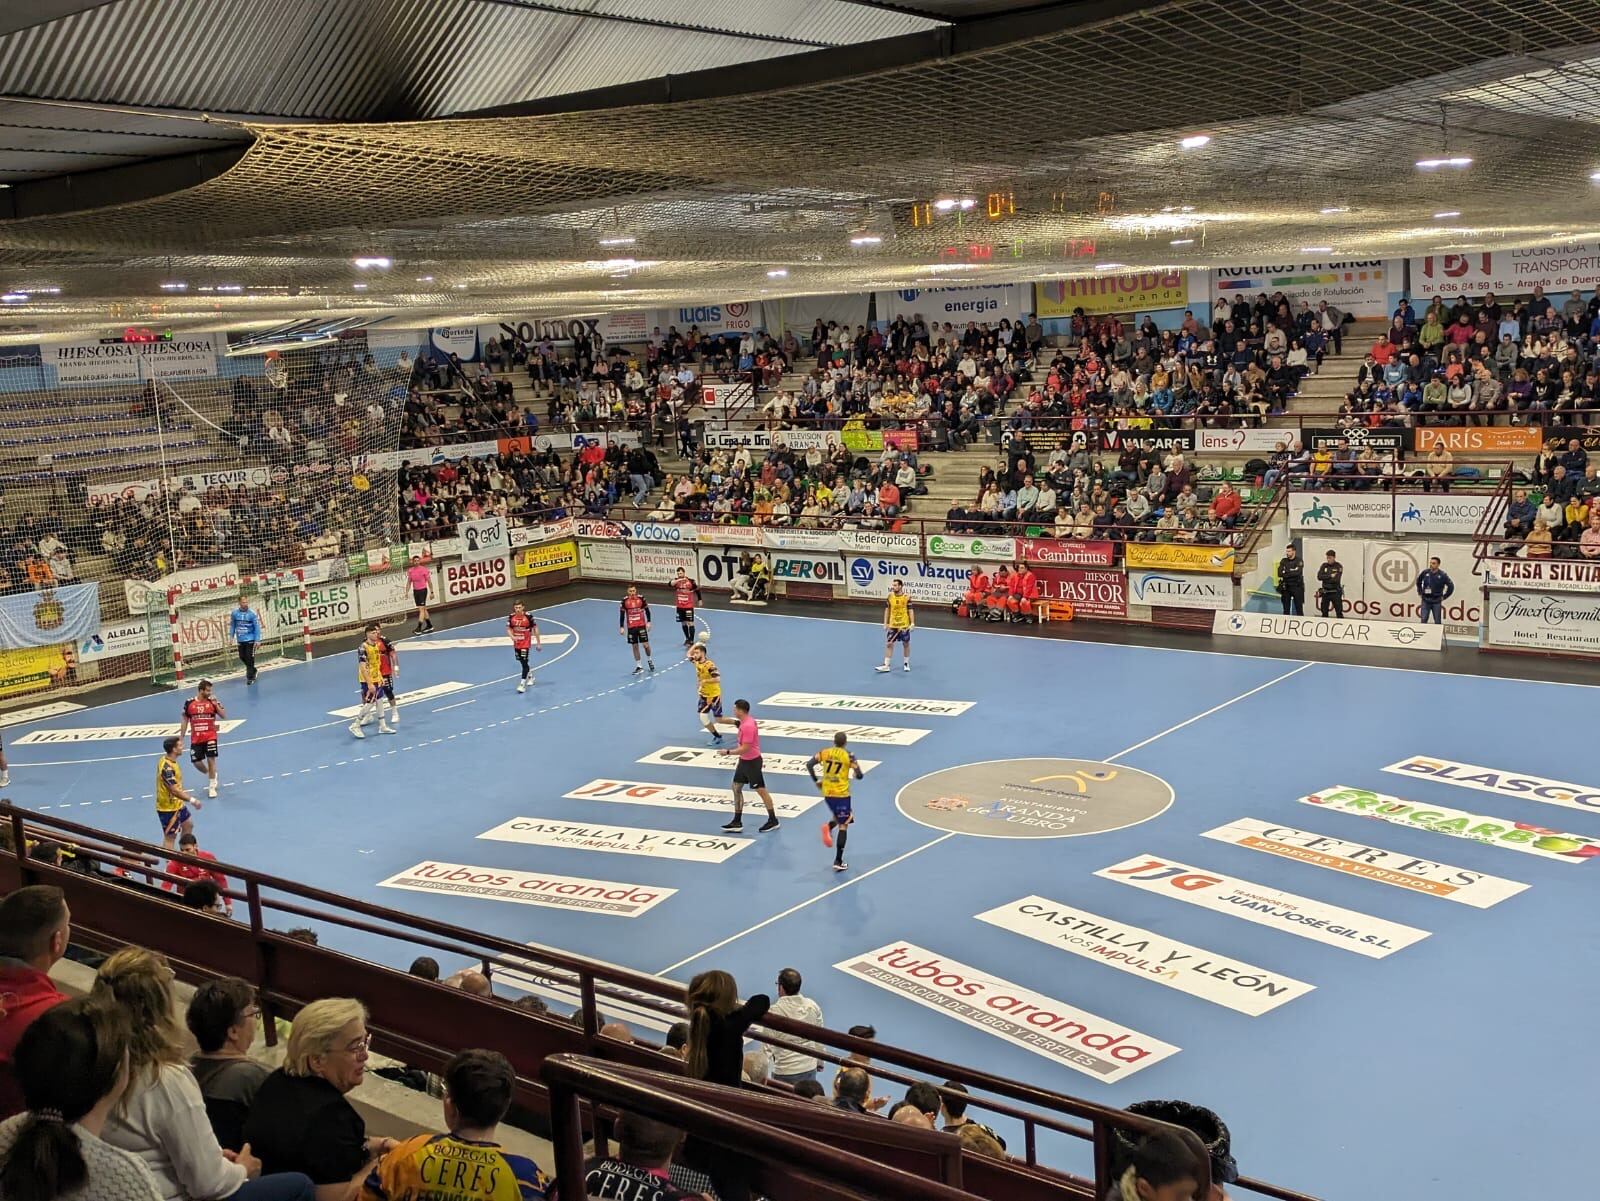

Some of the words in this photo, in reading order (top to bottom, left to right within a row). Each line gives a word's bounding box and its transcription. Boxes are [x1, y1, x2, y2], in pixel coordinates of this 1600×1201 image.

[1440, 282, 1458, 292] 636
[1461, 282, 1474, 291] 84
[1494, 281, 1504, 289] 15
[1517, 278, 1551, 288] Aranda
[1556, 277, 1568, 285] de
[944, 297, 998, 314] energía
[725, 319, 750, 329] FRIGO
[57, 344, 134, 360] HIESCOSA
[142, 341, 213, 355] HIESCOSA
[719, 434, 739, 448] Cepa
[742, 434, 752, 445] de
[754, 434, 770, 446] Oro
[1201, 431, 1228, 449] lens
[1420, 428, 1484, 449] PARÍS
[201, 470, 247, 486] TECVIR
[1346, 503, 1392, 512] INMOBICORP
[634, 555, 655, 564] RAFA
[1037, 547, 1108, 565] Gambrinus
[447, 558, 506, 581] BASILIO
[877, 560, 909, 577] Siro
[1501, 562, 1543, 580] CASA
[1549, 563, 1600, 583] SILVIA
[449, 573, 507, 596] CRIADO
[1059, 580, 1125, 604] PASTOR
[1259, 617, 1371, 642] BURGOCAR
[1513, 630, 1538, 639] Hotel
[830, 699, 958, 713] MultiRiber
[825, 760, 843, 775] 77
[666, 794, 709, 804] JUAN
[999, 797, 1088, 815] AYUNTAMIENTO
[966, 806, 991, 815] de
[511, 821, 624, 842] CASTILLA
[638, 834, 659, 845] Y
[662, 835, 738, 852] LEÓN
[1253, 840, 1333, 866] BODEGAS
[1334, 860, 1347, 869] Y
[1348, 863, 1439, 892] VIÑEDOS
[1262, 827, 1485, 887] CERES
[413, 863, 516, 886] tubos
[518, 876, 661, 904] aranda
[1107, 860, 1225, 891] JJG
[487, 888, 505, 896] DE
[506, 890, 548, 901] TUBOS
[555, 898, 620, 911] PERFILES
[1223, 889, 1299, 912] TRANSPORTES
[1217, 894, 1278, 917] JUAN
[1271, 910, 1331, 929] JOSÉ
[1325, 924, 1359, 939] GIL
[1358, 933, 1393, 950] S.L.
[1018, 903, 1151, 953] CASTILLA
[1159, 949, 1193, 963] Y
[1192, 961, 1289, 998] LEÓN
[876, 947, 986, 996] tubos
[985, 995, 1153, 1064] aranda
[947, 999, 968, 1012] DE
[966, 1010, 1012, 1034] TUBOS
[1011, 1027, 1024, 1037] Y
[1022, 1031, 1097, 1067] PERFILES
[433, 1144, 498, 1165] BODEGAS
[419, 1155, 501, 1195] CERES
[600, 1159, 662, 1188] BODEGAS
